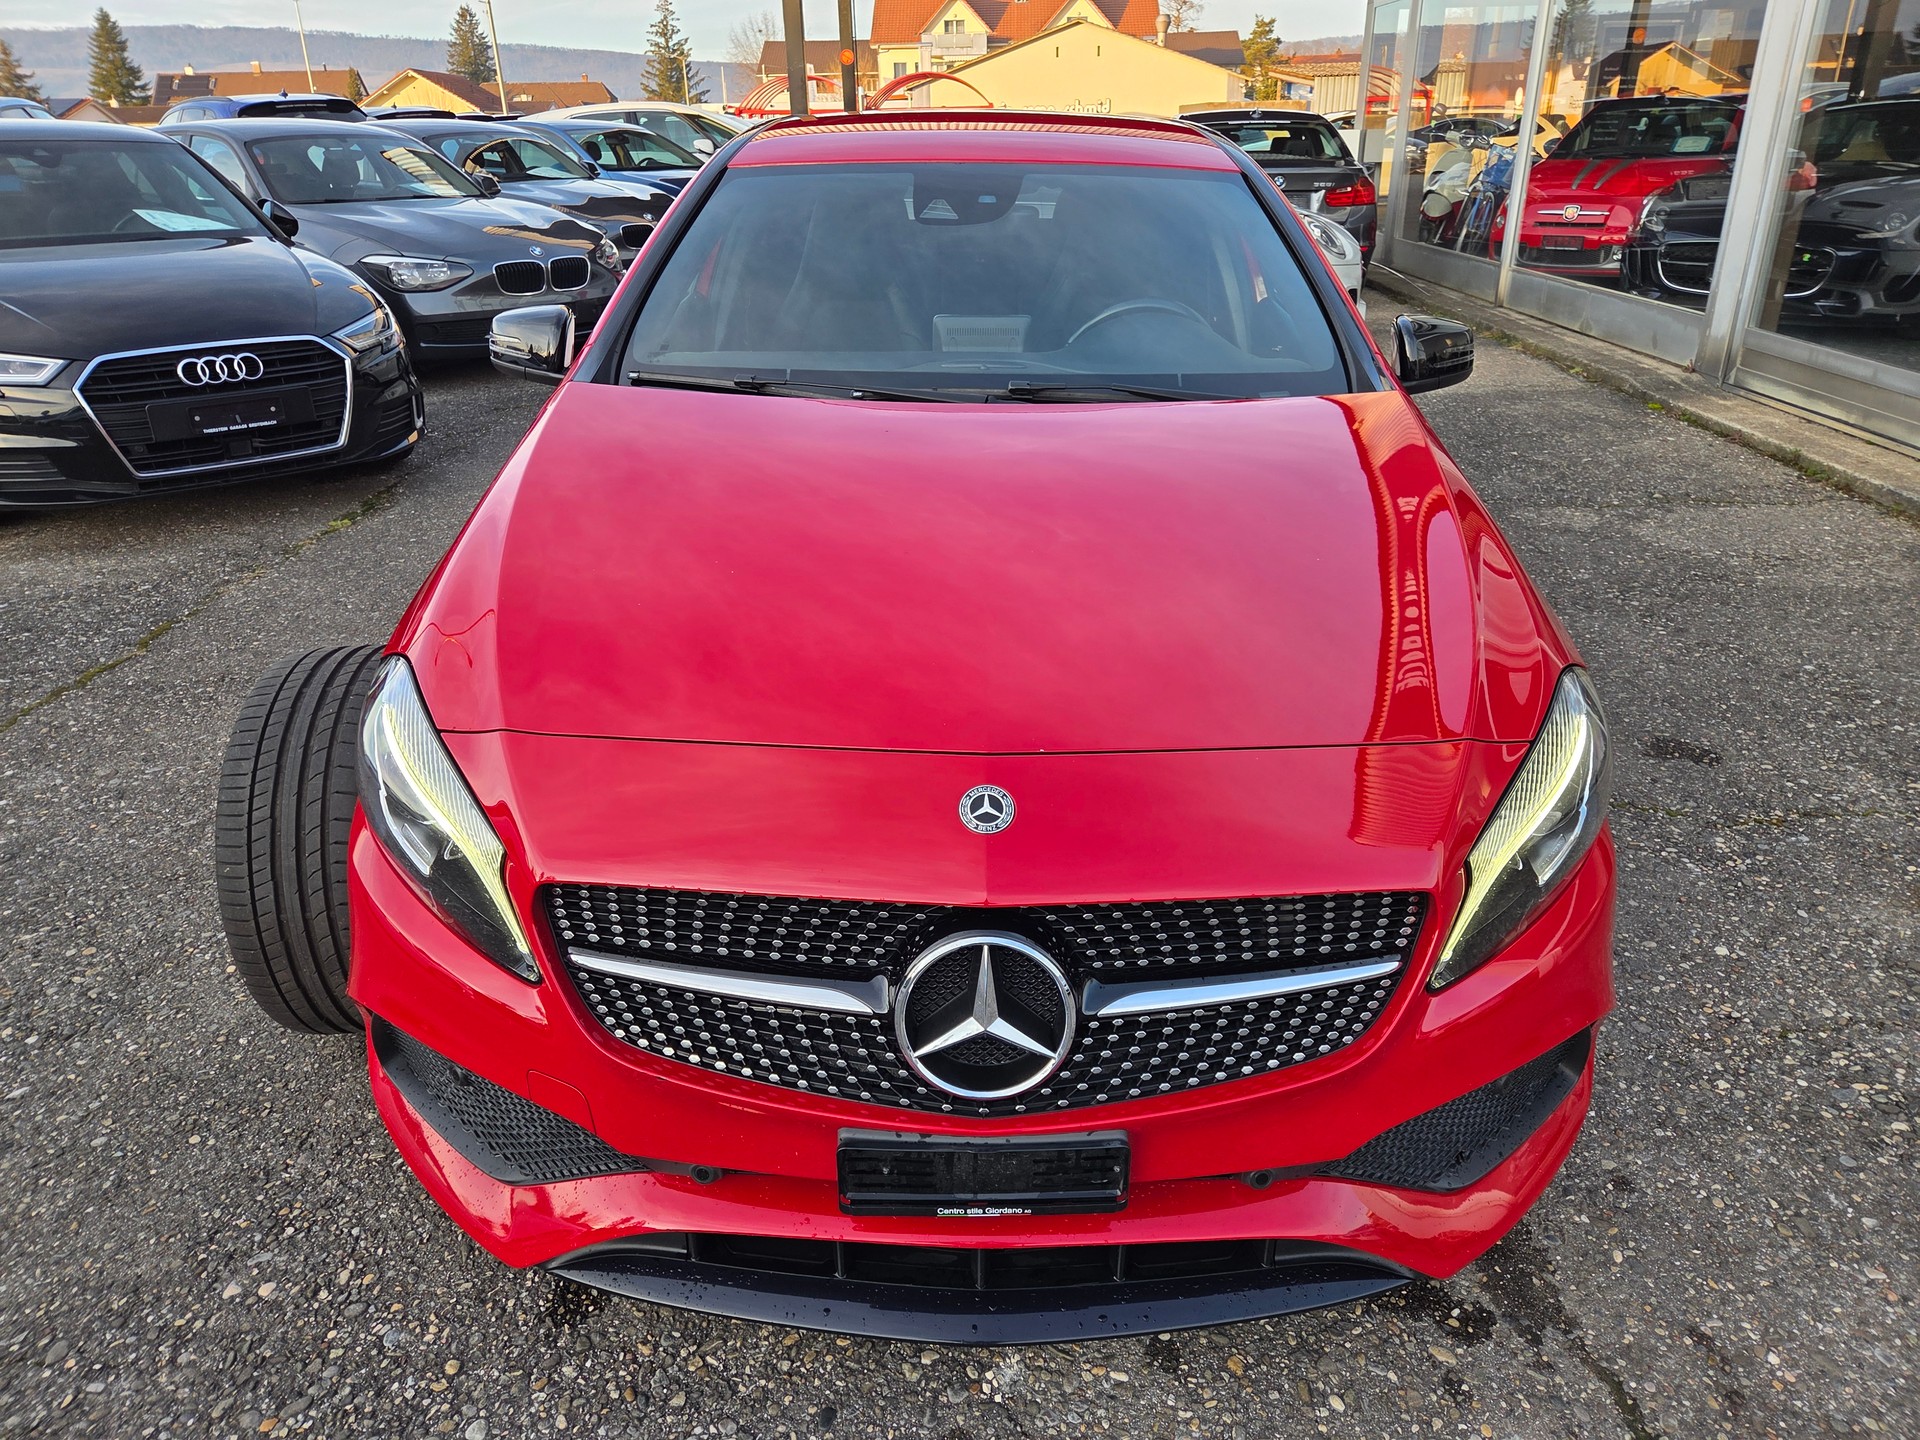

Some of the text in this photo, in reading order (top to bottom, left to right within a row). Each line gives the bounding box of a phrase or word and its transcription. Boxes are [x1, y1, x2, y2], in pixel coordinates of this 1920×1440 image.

[969, 786, 1005, 797] MERCEDES
[977, 824, 998, 832] BENZ
[937, 1207, 965, 1215] Centro
